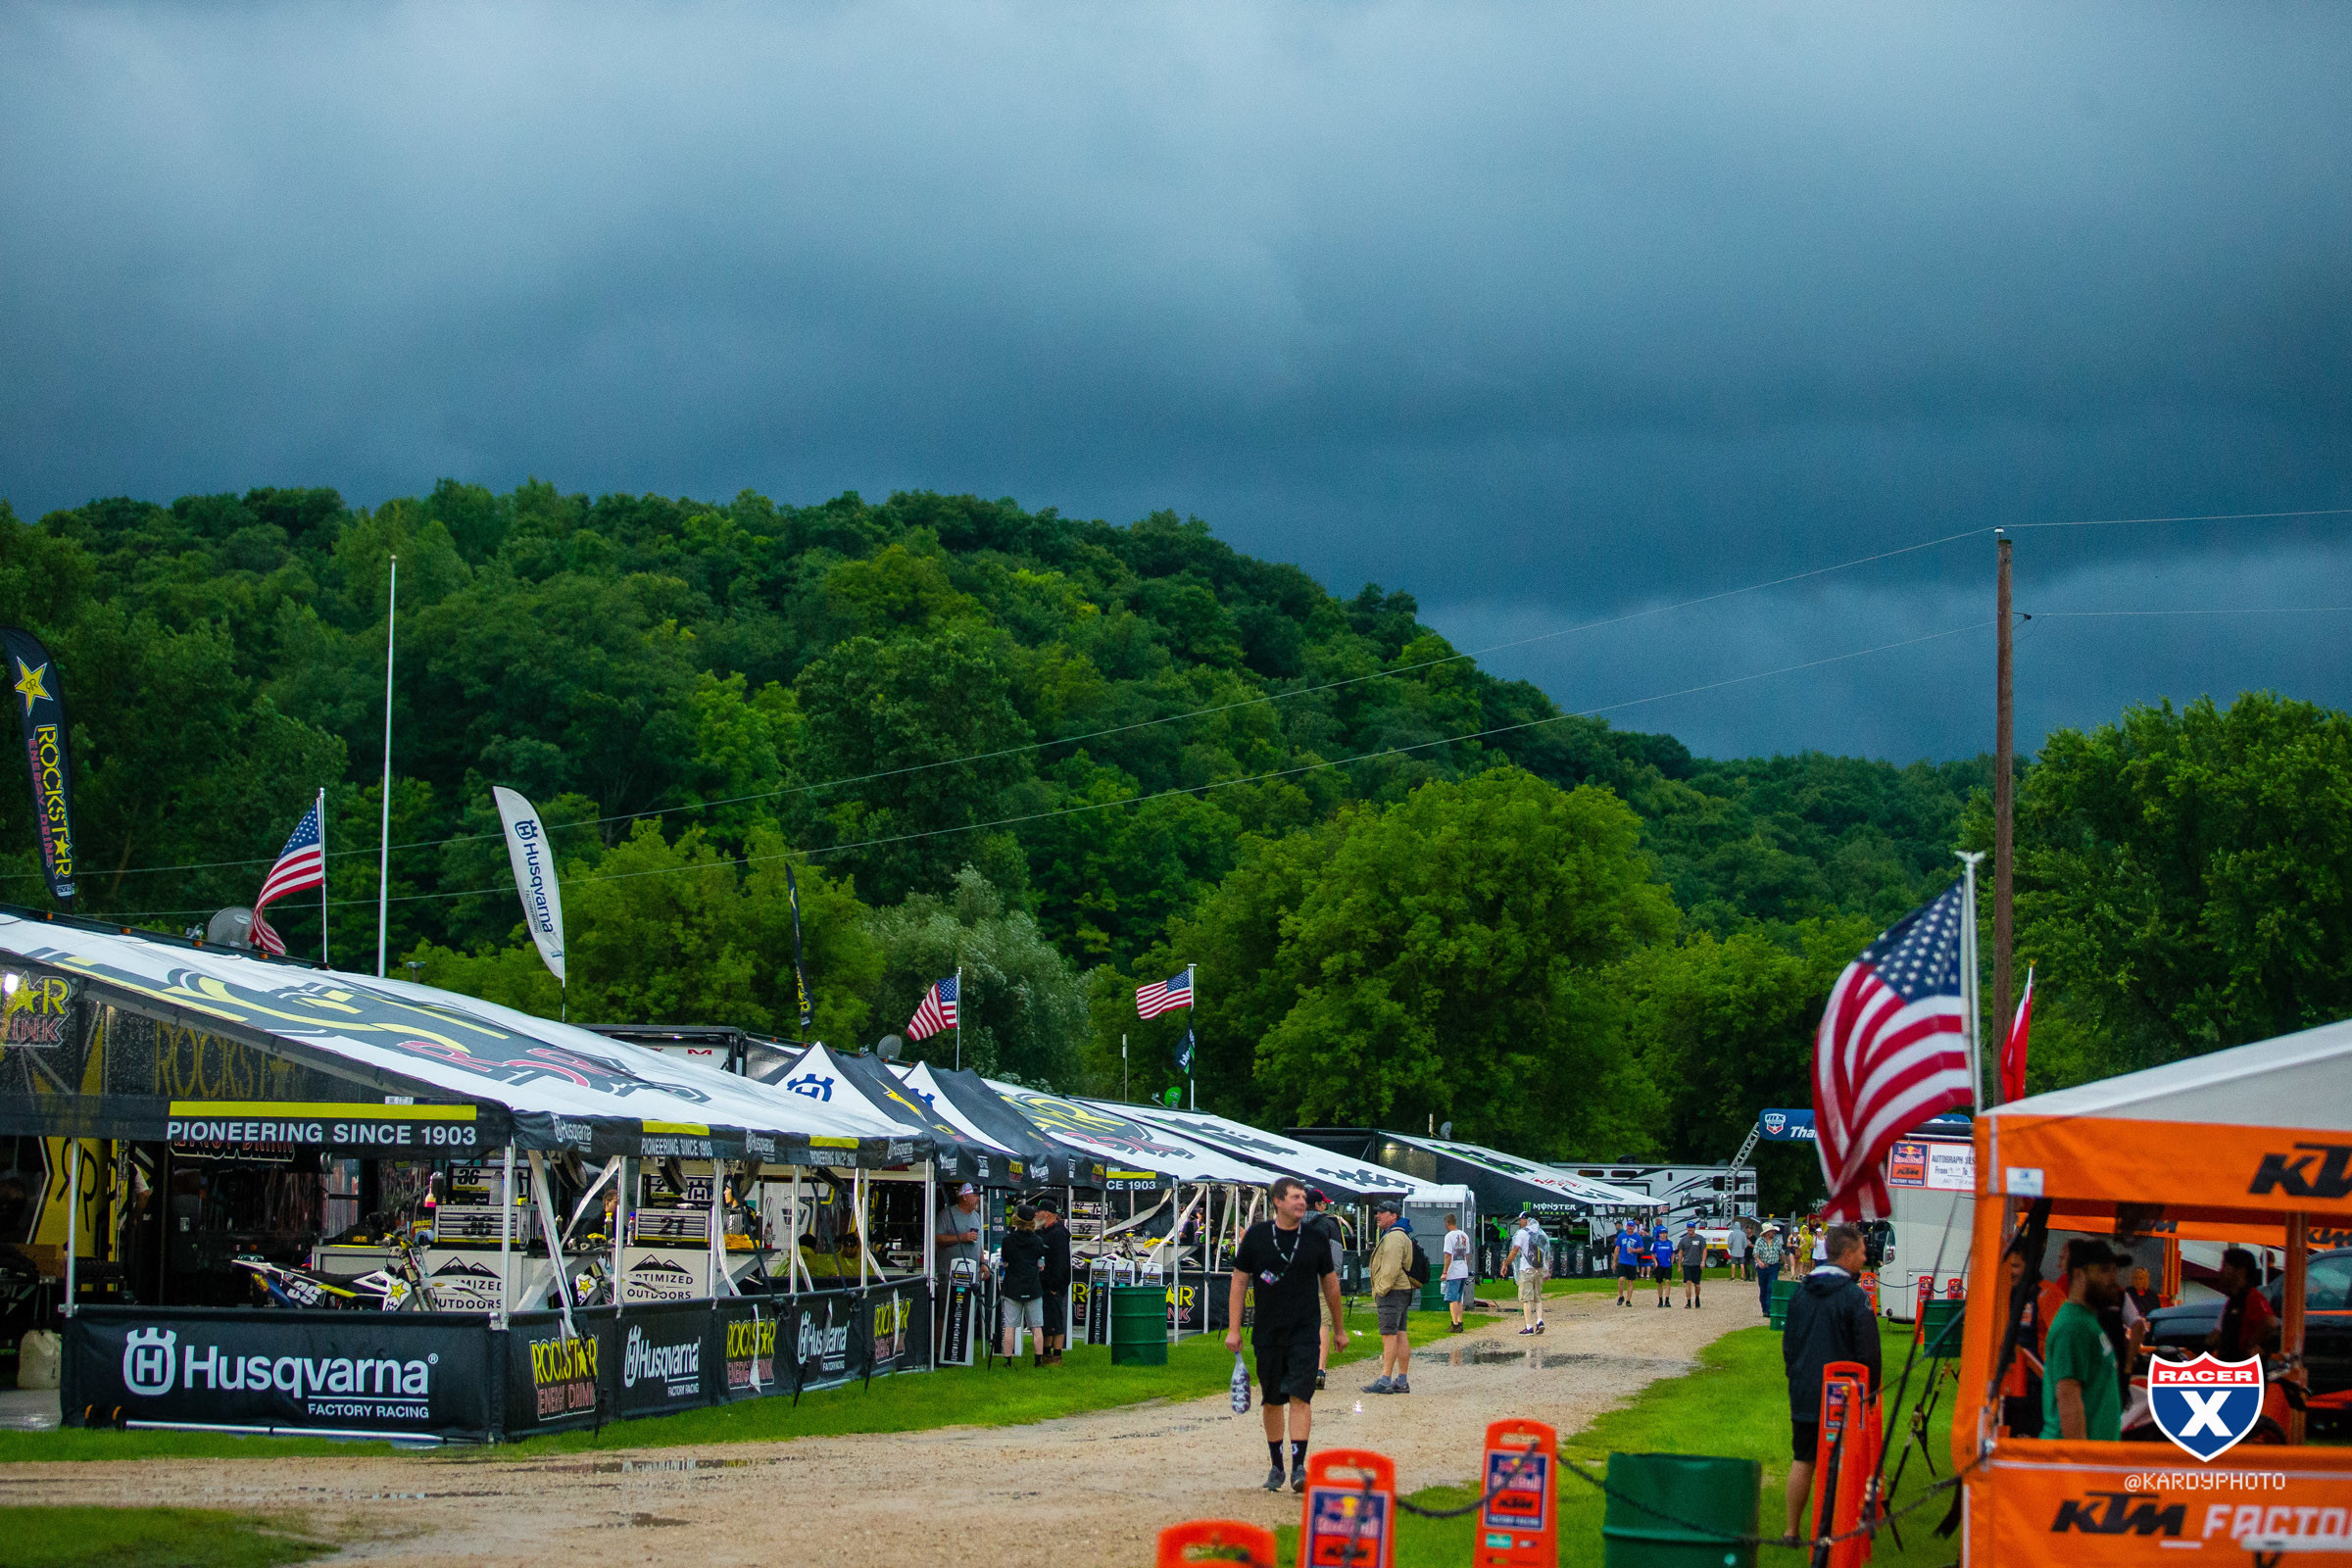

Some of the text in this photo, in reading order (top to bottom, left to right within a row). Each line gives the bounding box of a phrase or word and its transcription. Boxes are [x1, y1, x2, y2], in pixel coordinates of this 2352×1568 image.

[27, 739, 53, 868] ENERGY DRINK
[166, 1121, 477, 1146] PIONEERING SINCE 1903
[1790, 1126, 1817, 1139] Tha
[641, 1138, 713, 1157] PIONEERING SINCE 1903
[1931, 1155, 1976, 1165] AUTOGRAPH SES
[458, 1169, 480, 1186] 36
[1935, 1166, 1948, 1175] From
[2247, 1142, 2352, 1199] KT
[1128, 1180, 1156, 1191] 1903
[1533, 1202, 1577, 1211] MONSTER
[660, 1216, 686, 1235] 21
[638, 1339, 700, 1383] Husqvarna
[568, 1382, 596, 1408] DRINK
[308, 1403, 429, 1419] FACTORY RACING
[2050, 1491, 2352, 1541] KTM FACTO
